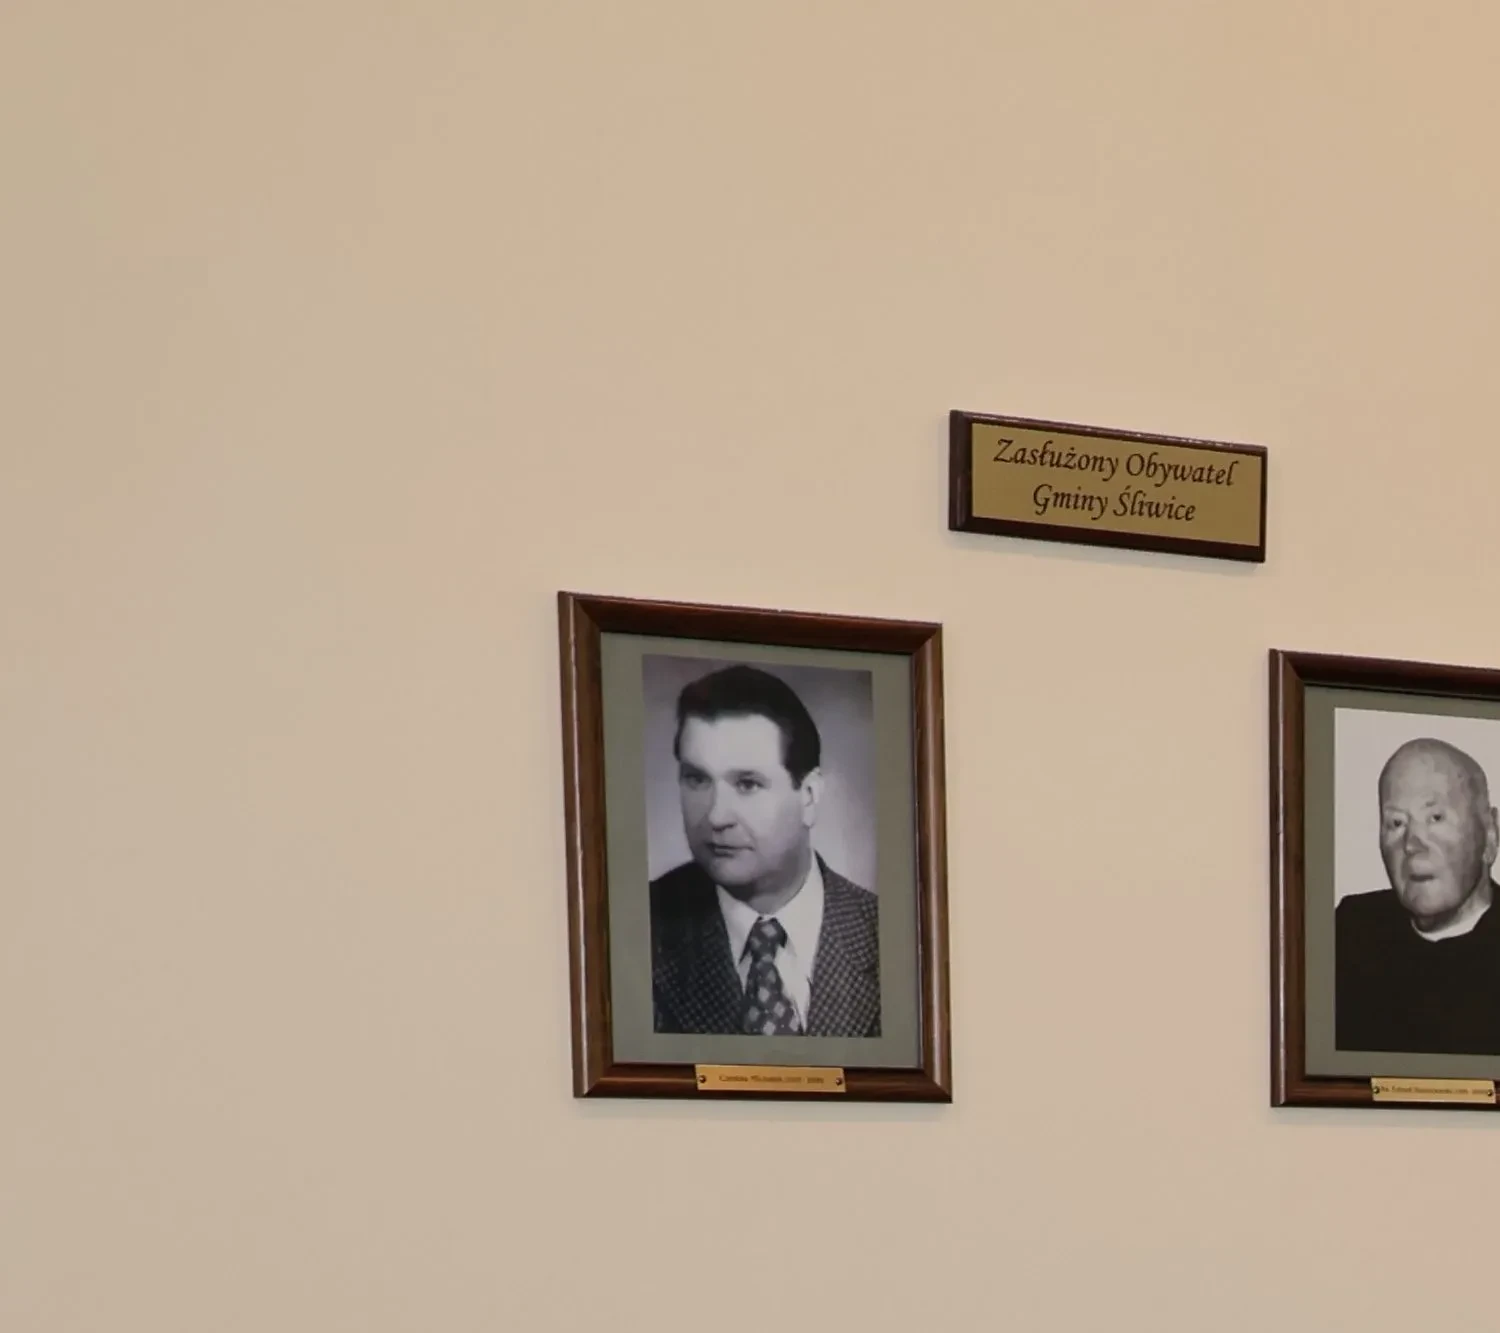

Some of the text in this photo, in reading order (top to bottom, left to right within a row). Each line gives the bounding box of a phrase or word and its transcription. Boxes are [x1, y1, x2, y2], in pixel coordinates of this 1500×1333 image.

[993, 438, 1239, 488] Zasłużony Obywatel
[1032, 483, 1197, 522] Gminy Śliwice
